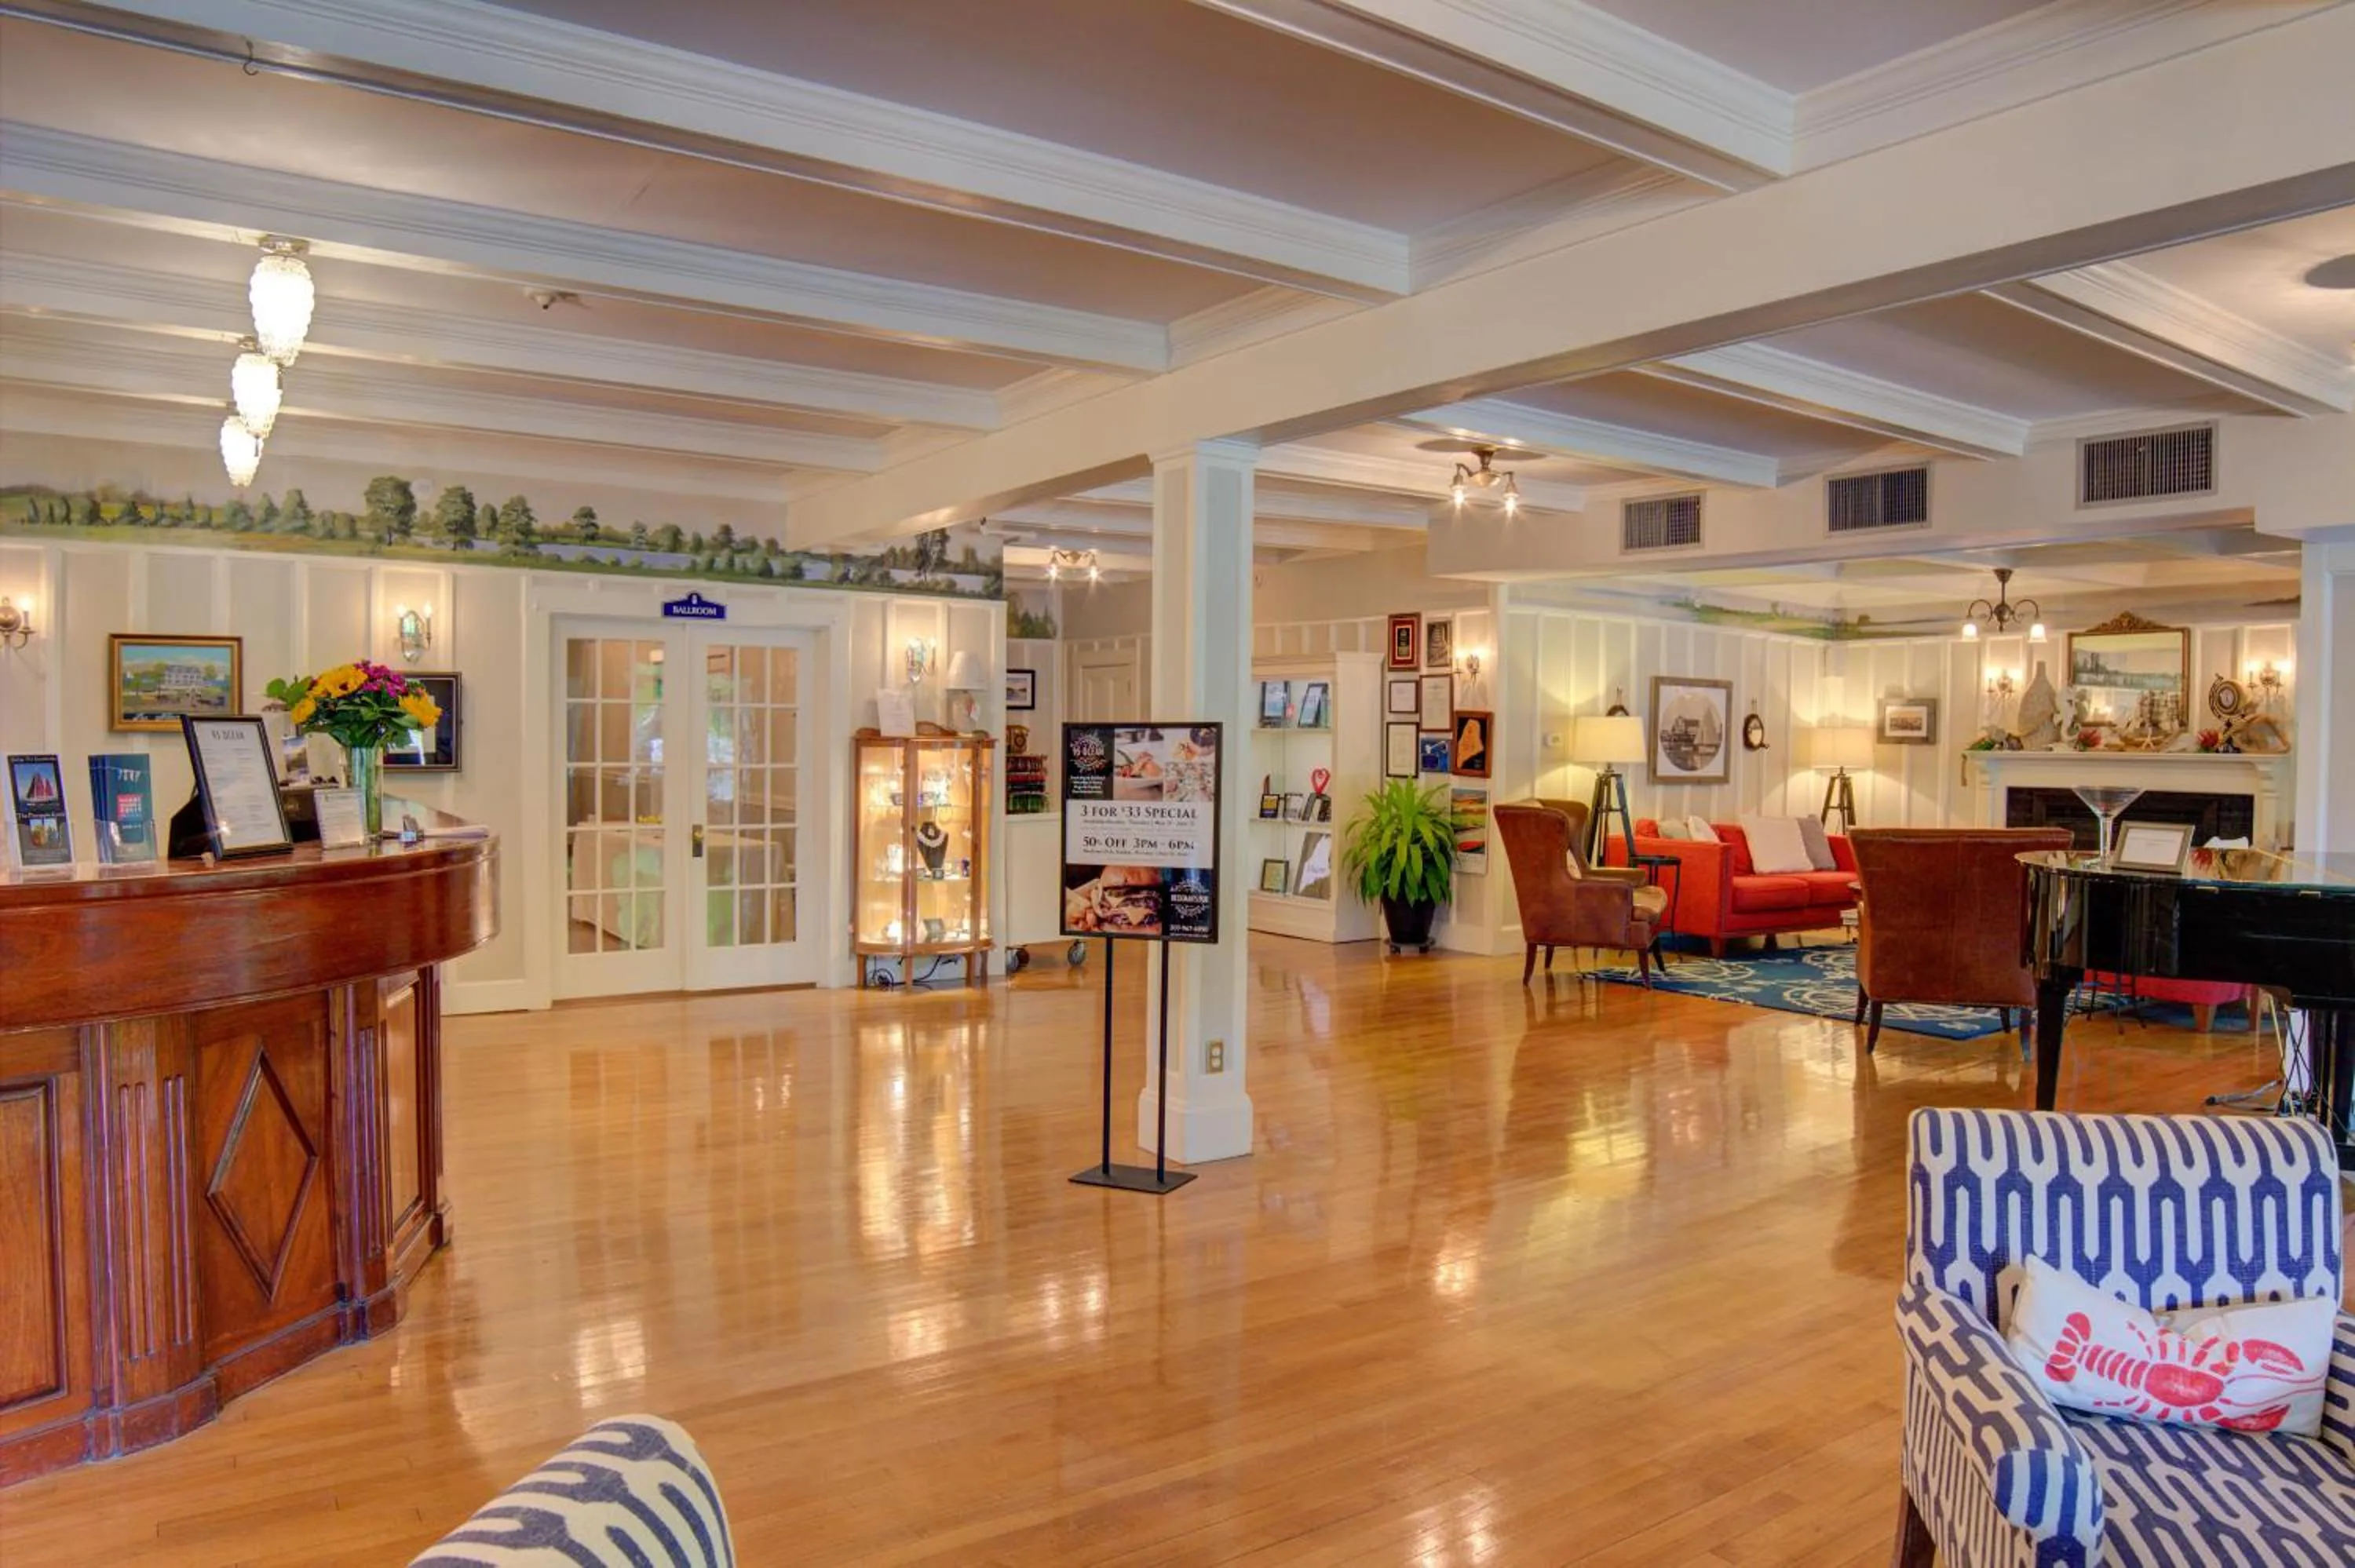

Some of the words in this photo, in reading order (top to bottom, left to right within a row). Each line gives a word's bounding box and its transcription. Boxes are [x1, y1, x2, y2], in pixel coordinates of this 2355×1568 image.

[672, 605, 717, 616] BALLROOM
[1080, 804, 1088, 817] 3
[1092, 806, 1118, 817] FOR
[1145, 806, 1199, 819] SPECIAL
[1104, 837, 1127, 848] OFF
[1133, 837, 1158, 848] 3PM
[1168, 838, 1194, 850] 6PM
